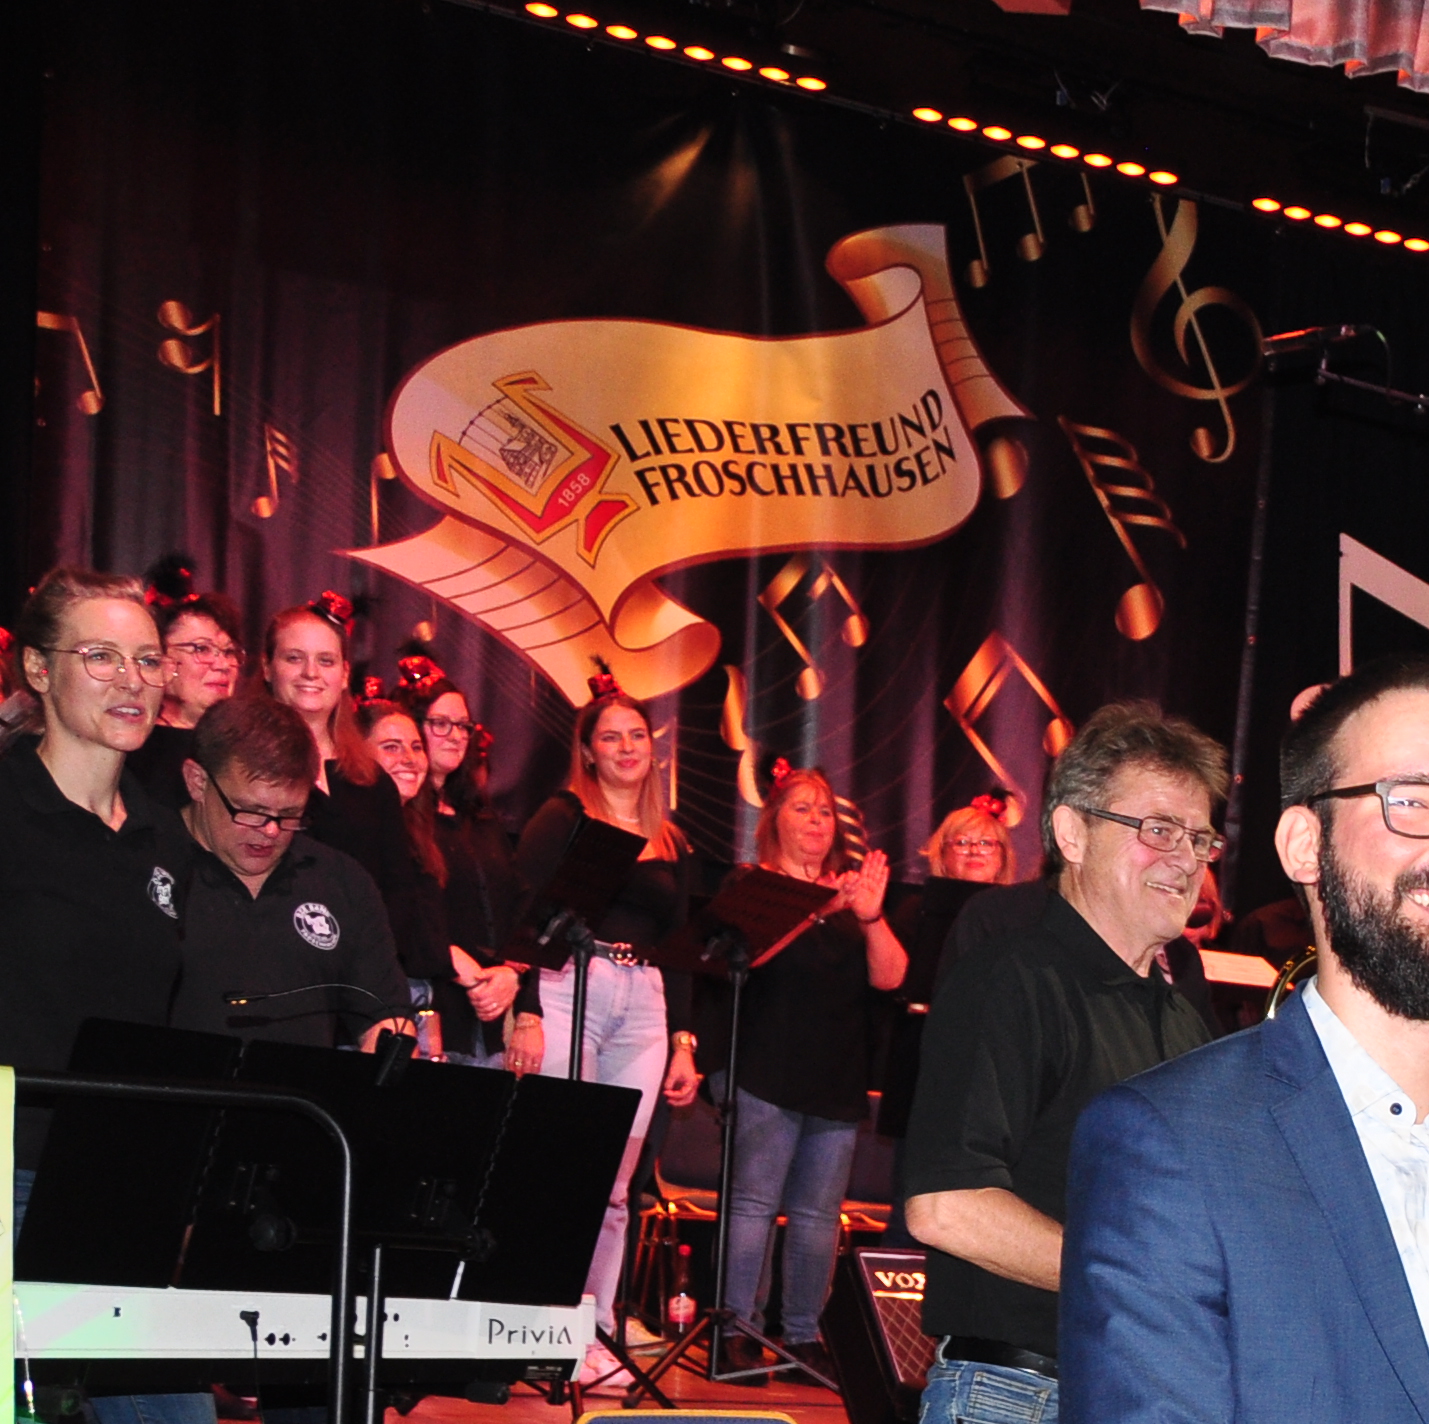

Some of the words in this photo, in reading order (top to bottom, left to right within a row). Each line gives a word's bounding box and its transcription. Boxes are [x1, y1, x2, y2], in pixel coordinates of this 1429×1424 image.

[609, 388, 944, 463] LIEDERFREUND
[557, 473, 591, 508] 1858
[634, 425, 957, 507] FROSCHHAUSEN
